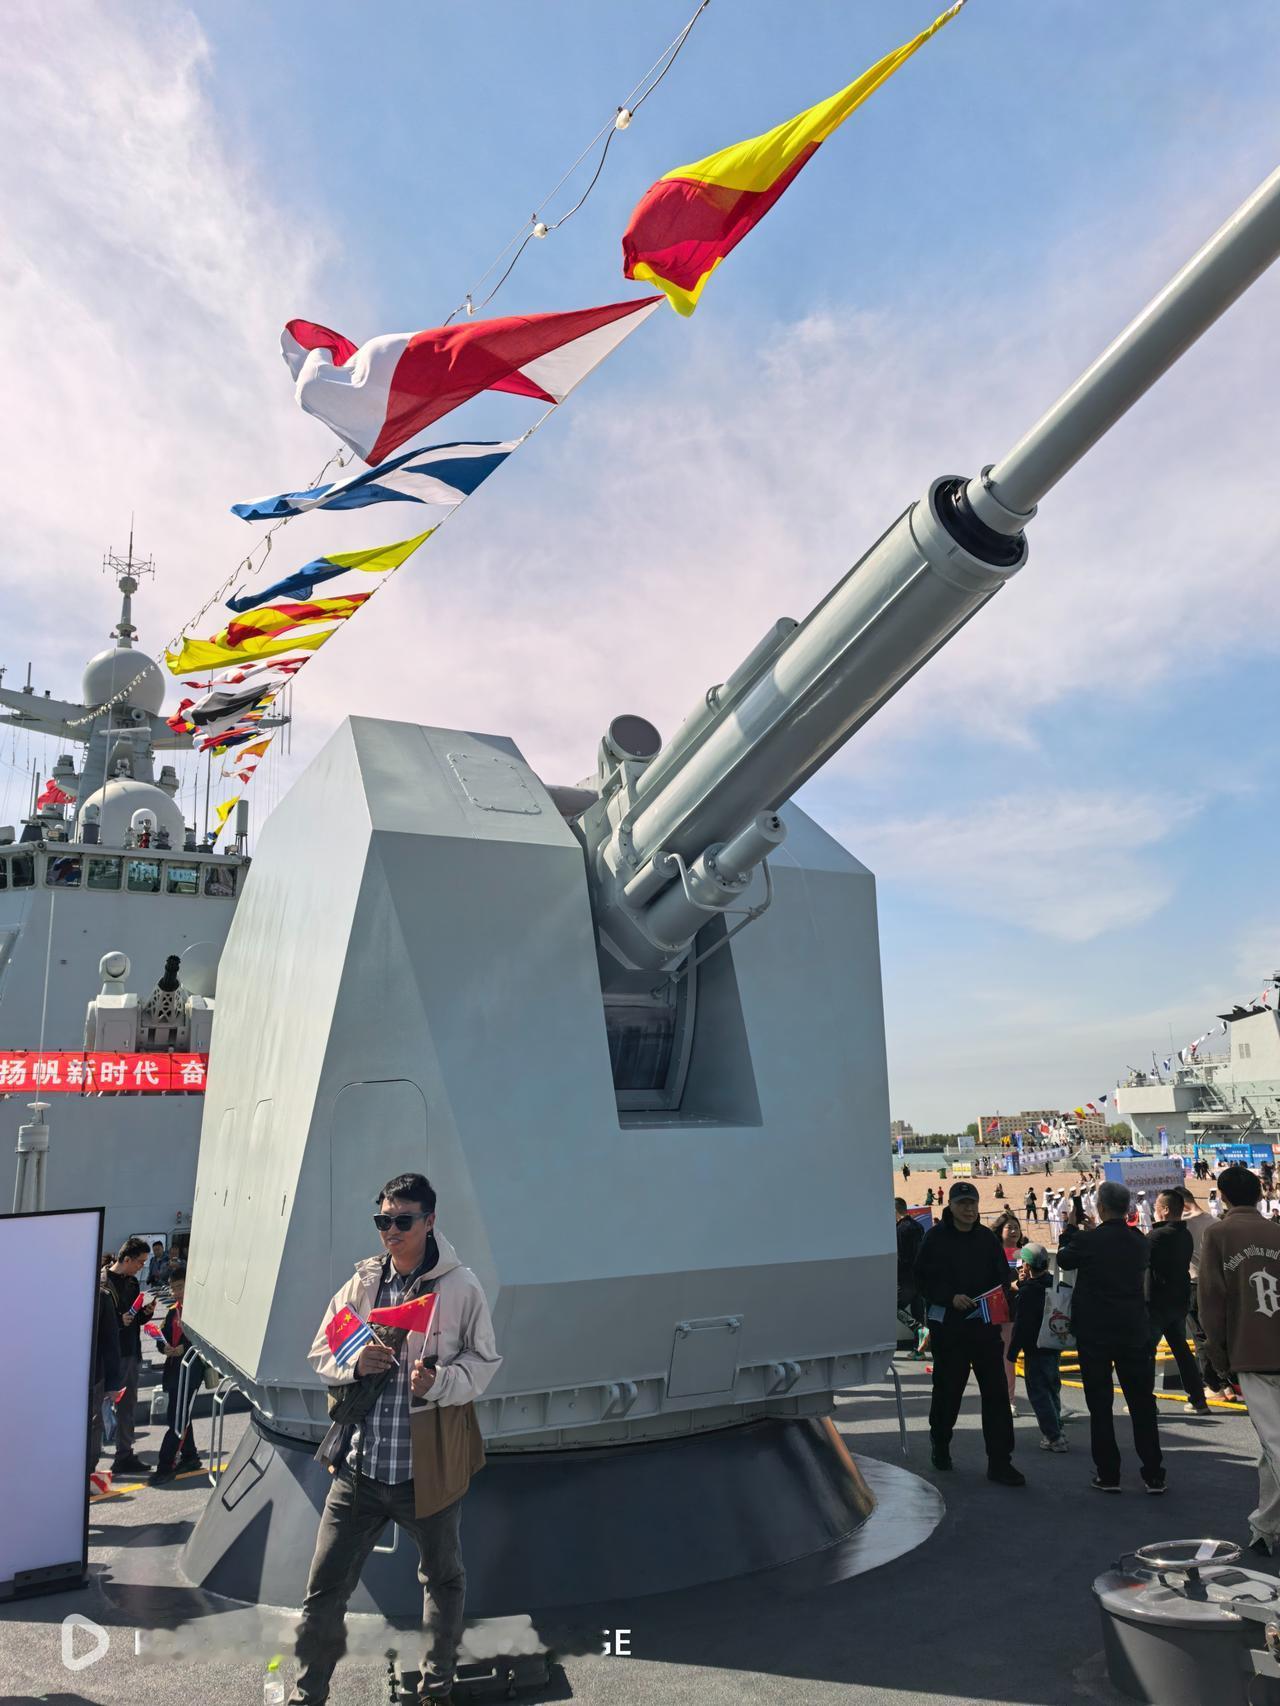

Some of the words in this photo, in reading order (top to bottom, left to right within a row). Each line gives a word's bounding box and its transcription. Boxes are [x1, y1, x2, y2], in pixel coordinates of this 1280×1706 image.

[0, 1059, 159, 1085] 扬帆新时代
[181, 1060, 206, 1085] 奋
